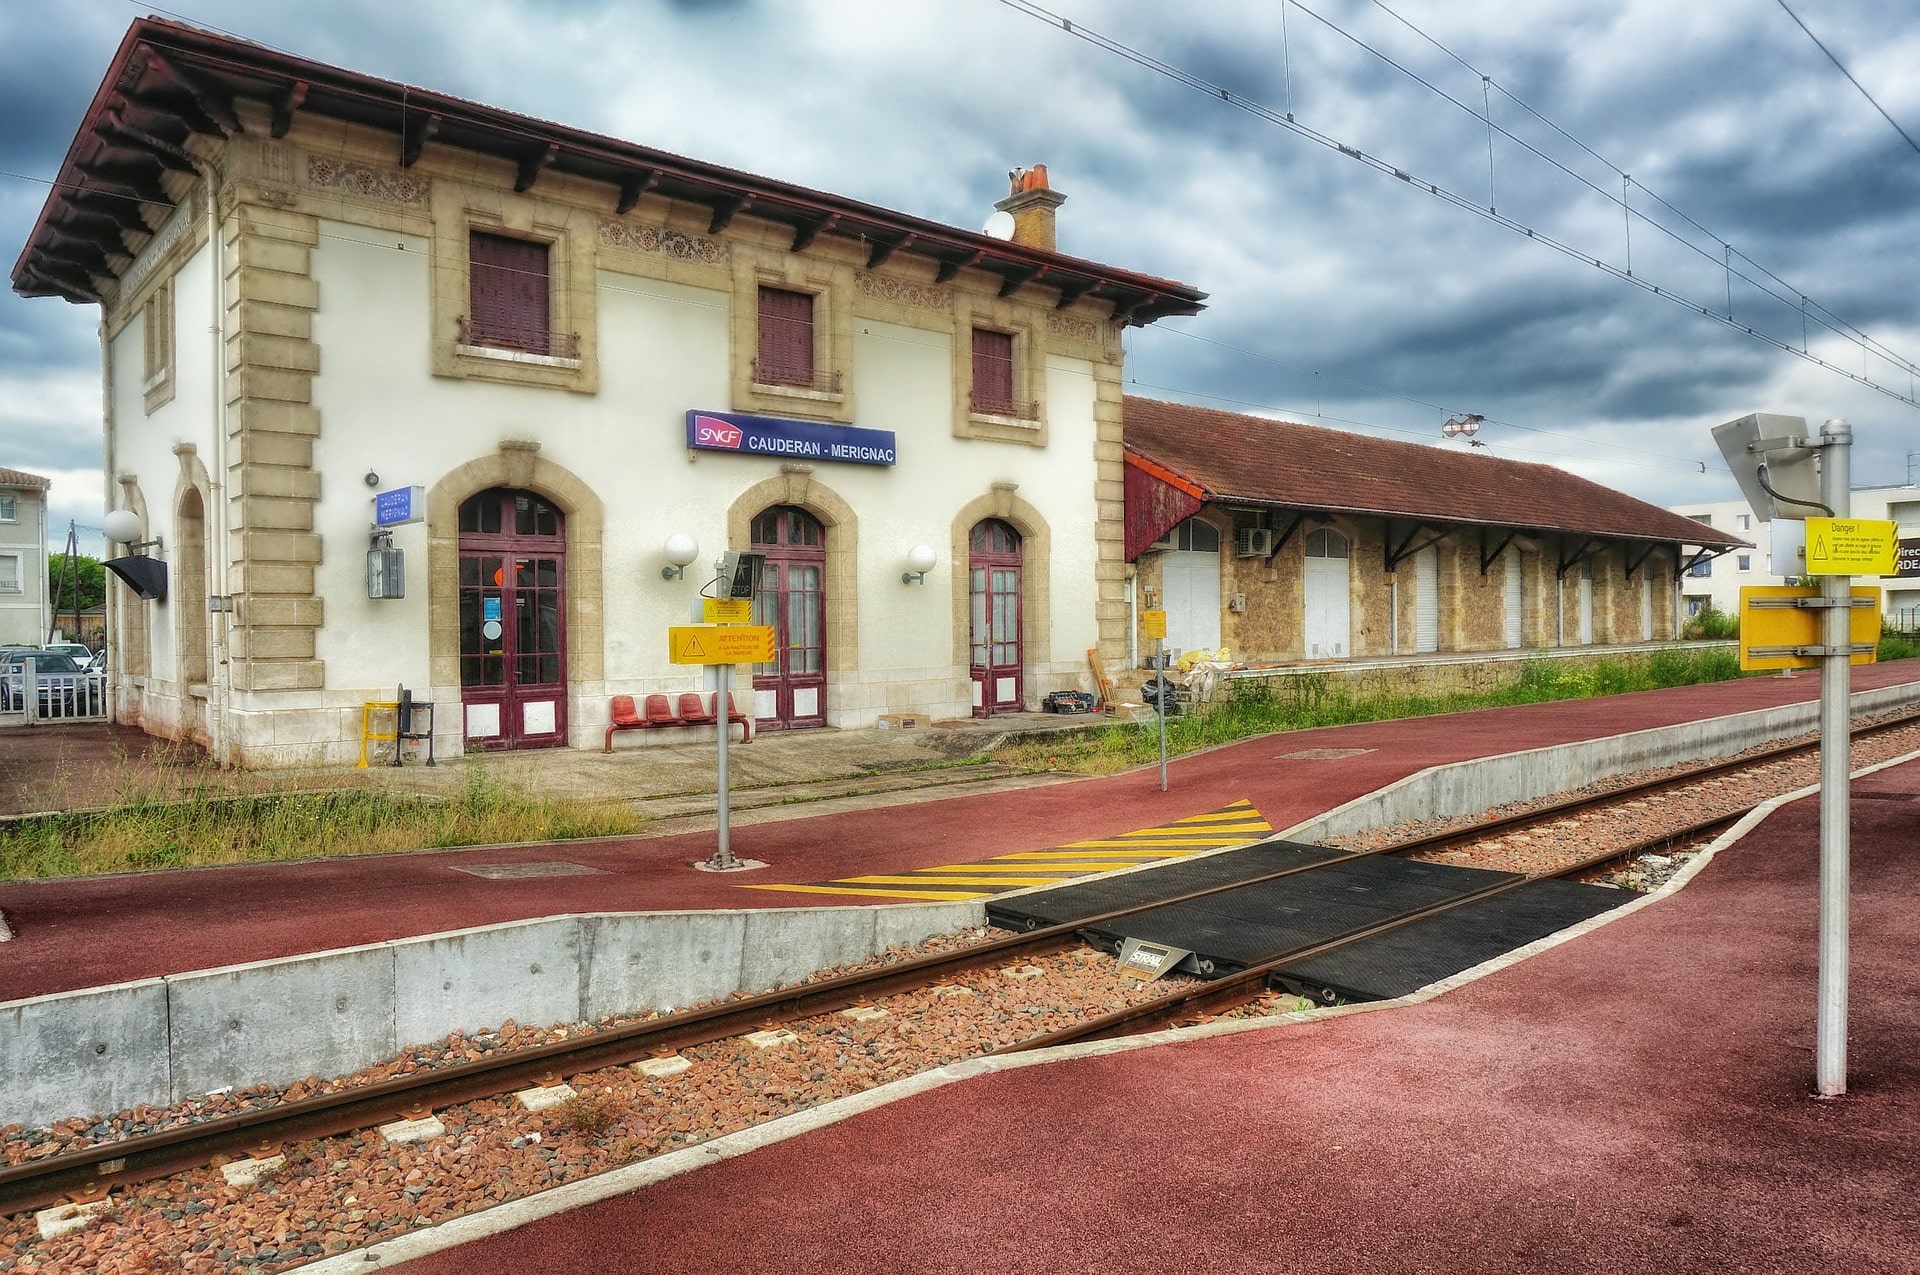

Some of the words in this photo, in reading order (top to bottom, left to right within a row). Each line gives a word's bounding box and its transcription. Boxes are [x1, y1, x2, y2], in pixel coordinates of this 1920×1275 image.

[699, 428, 739, 443] SNCF
[748, 436, 821, 455] CAUDERAN
[831, 443, 894, 462] MERIGNAC
[1832, 523, 1855, 534] Danger
[1898, 560, 1920, 570] RDE
[731, 584, 751, 594] STOP
